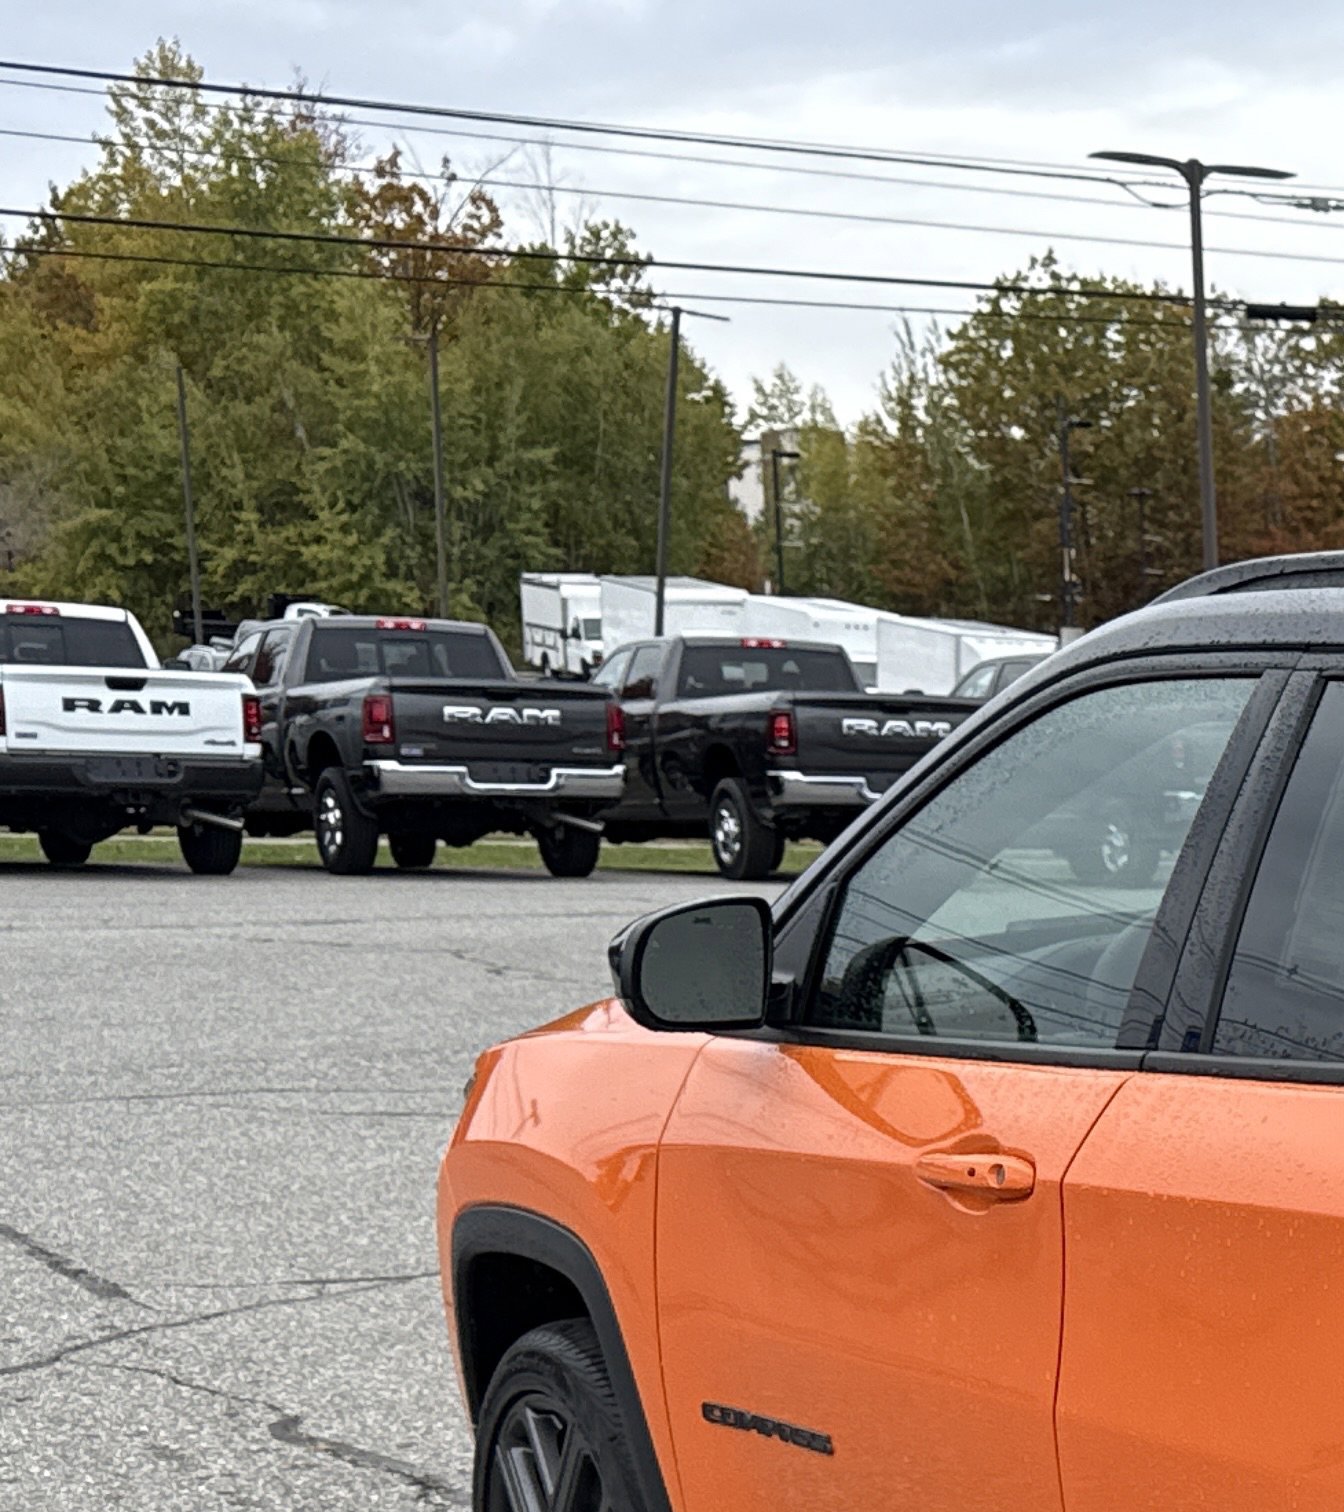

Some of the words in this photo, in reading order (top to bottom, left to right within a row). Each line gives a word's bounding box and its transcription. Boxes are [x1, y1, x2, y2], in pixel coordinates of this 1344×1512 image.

[62, 696, 190, 717] RAM
[443, 706, 561, 725] RAM
[841, 718, 952, 738] RAM
[702, 1402, 834, 1456] COMPASS
